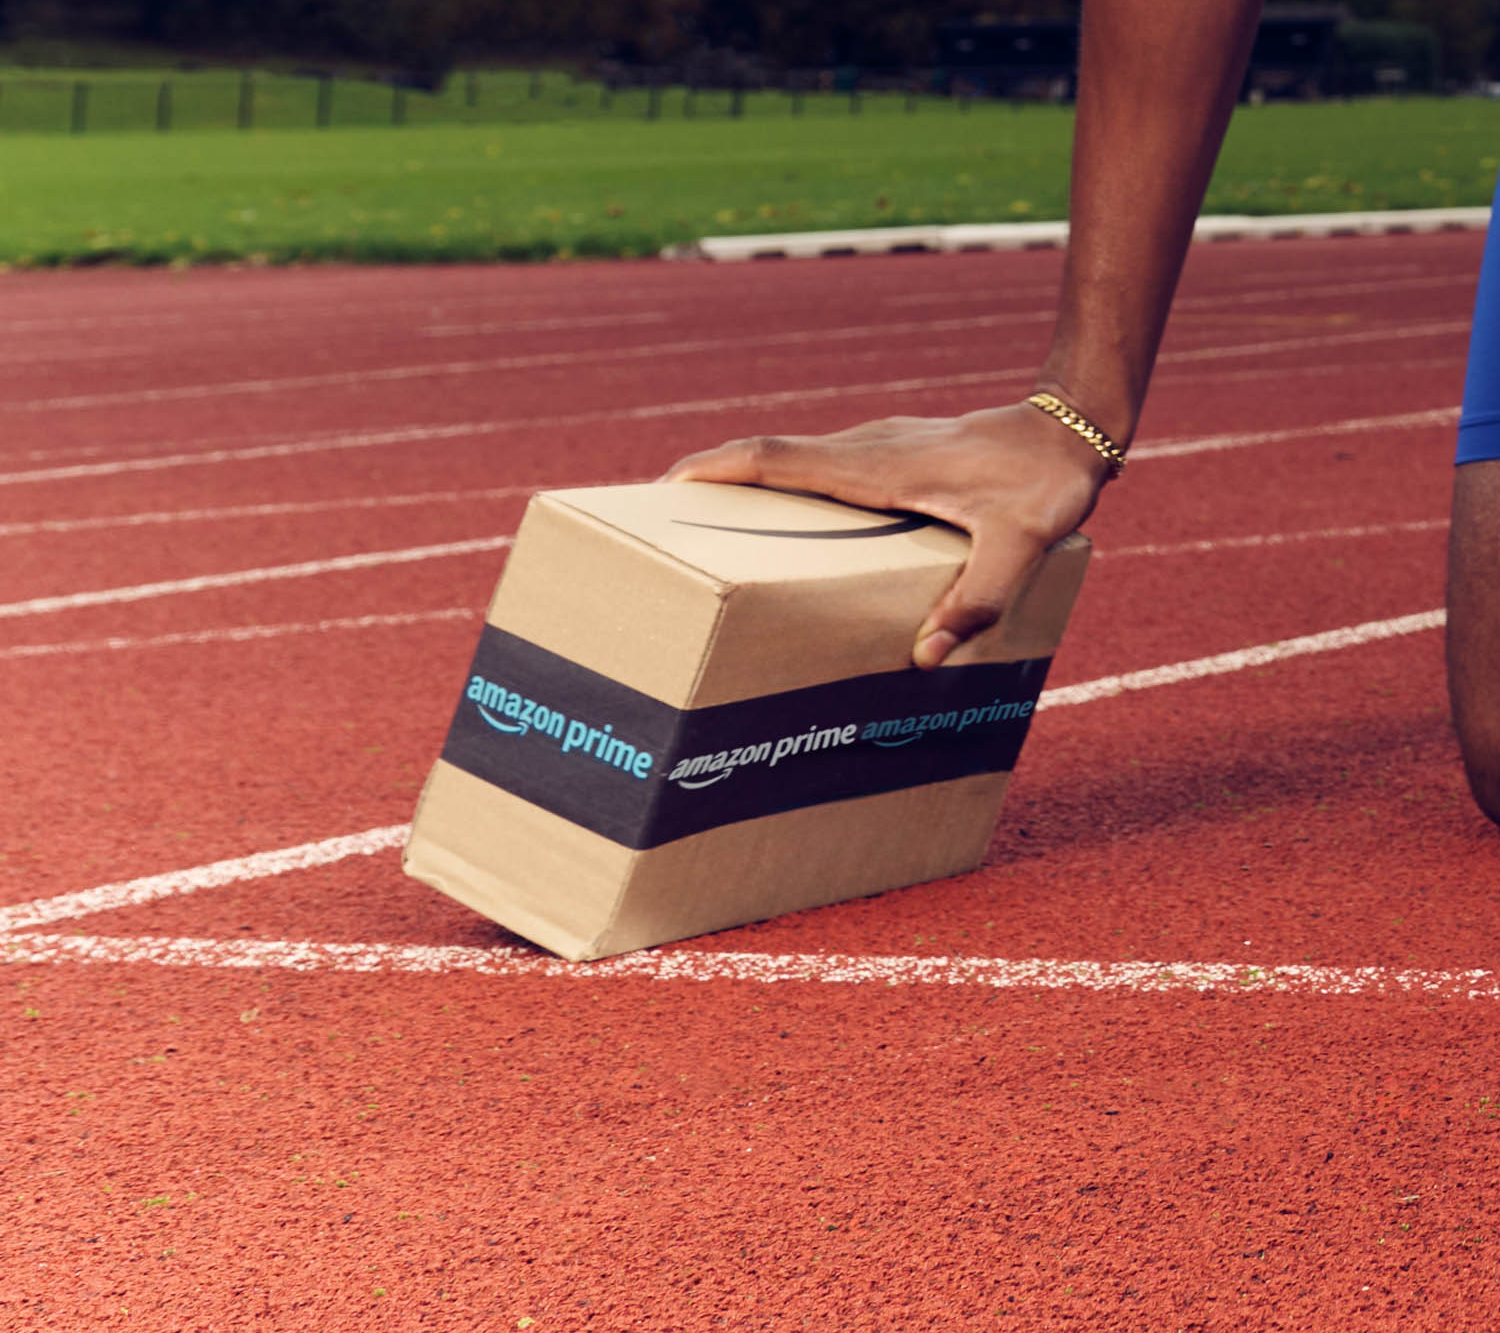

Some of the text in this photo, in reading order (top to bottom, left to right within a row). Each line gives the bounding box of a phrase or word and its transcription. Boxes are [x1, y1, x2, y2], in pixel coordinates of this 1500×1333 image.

[467, 673, 654, 780] amazon prime
[860, 698, 1035, 742] amazon prime
[669, 724, 857, 782] amazon prime
